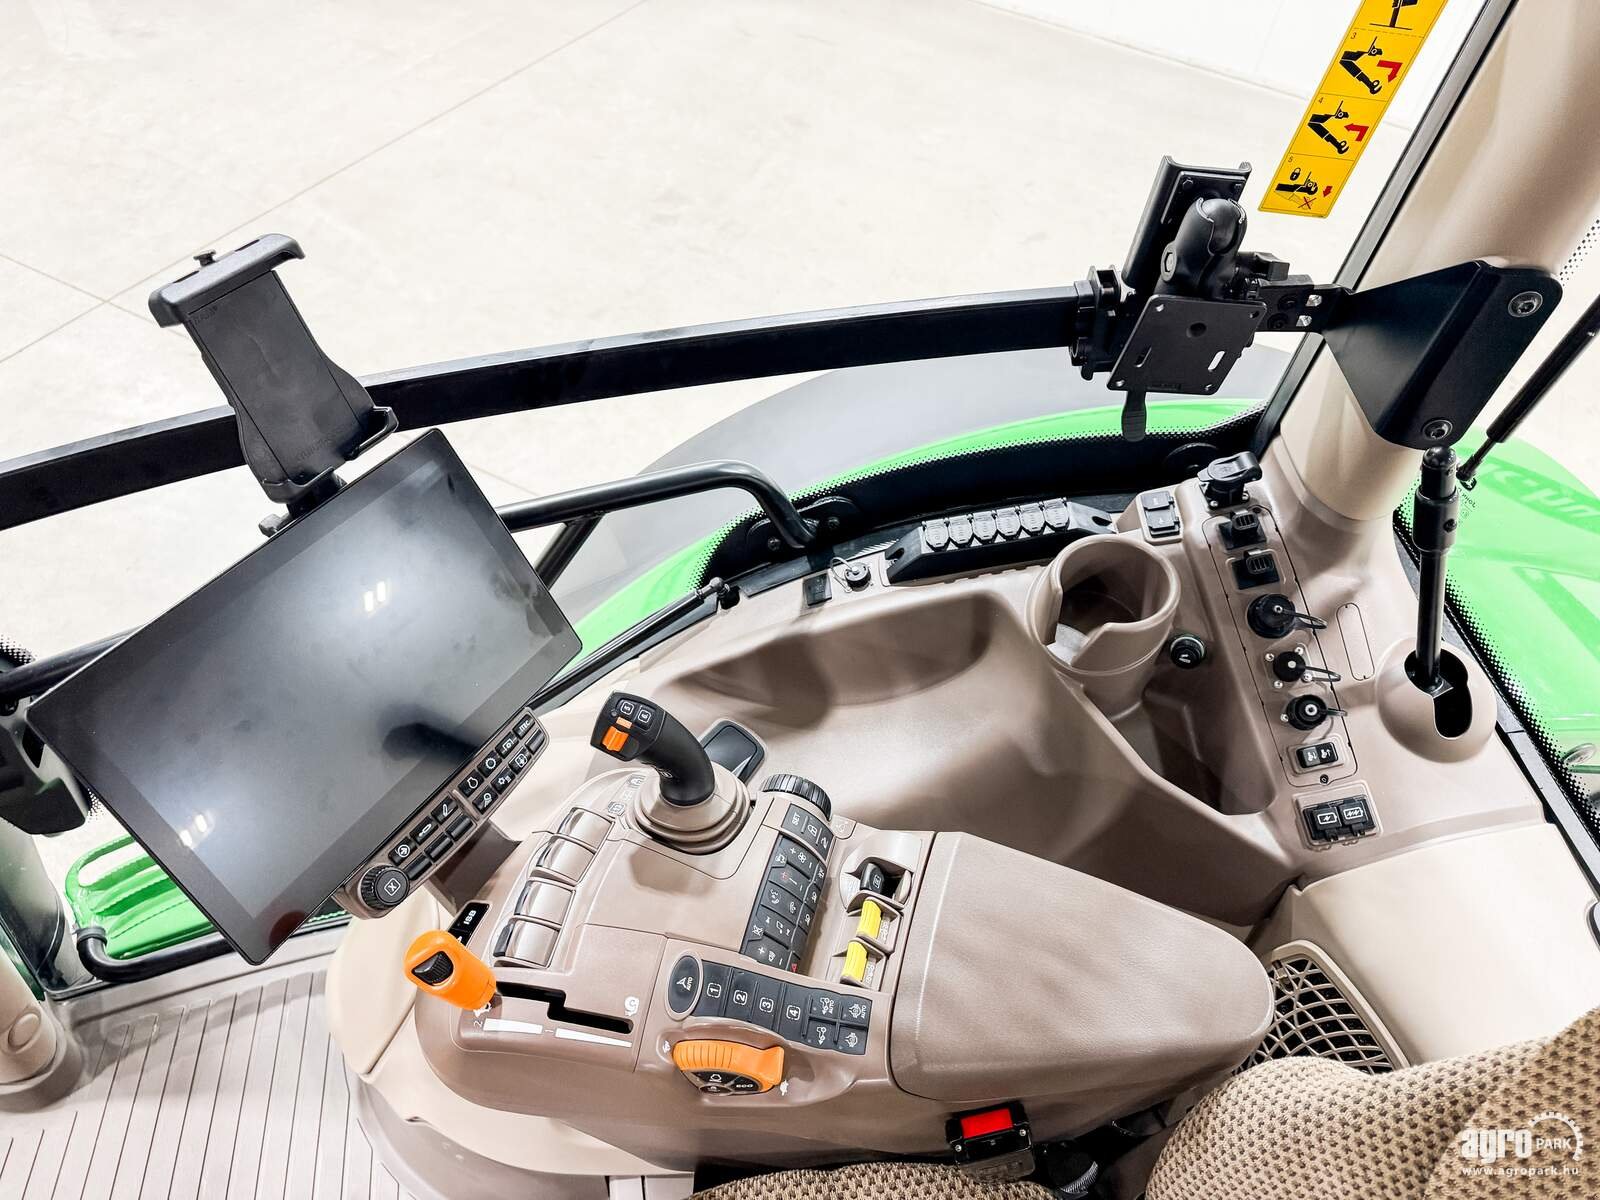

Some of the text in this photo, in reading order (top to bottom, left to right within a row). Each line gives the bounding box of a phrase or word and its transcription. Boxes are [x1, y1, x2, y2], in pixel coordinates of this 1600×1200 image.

[1351, 32, 1357, 40] 3
[792, 812, 800, 825] SET
[685, 976, 693, 992] AUTO
